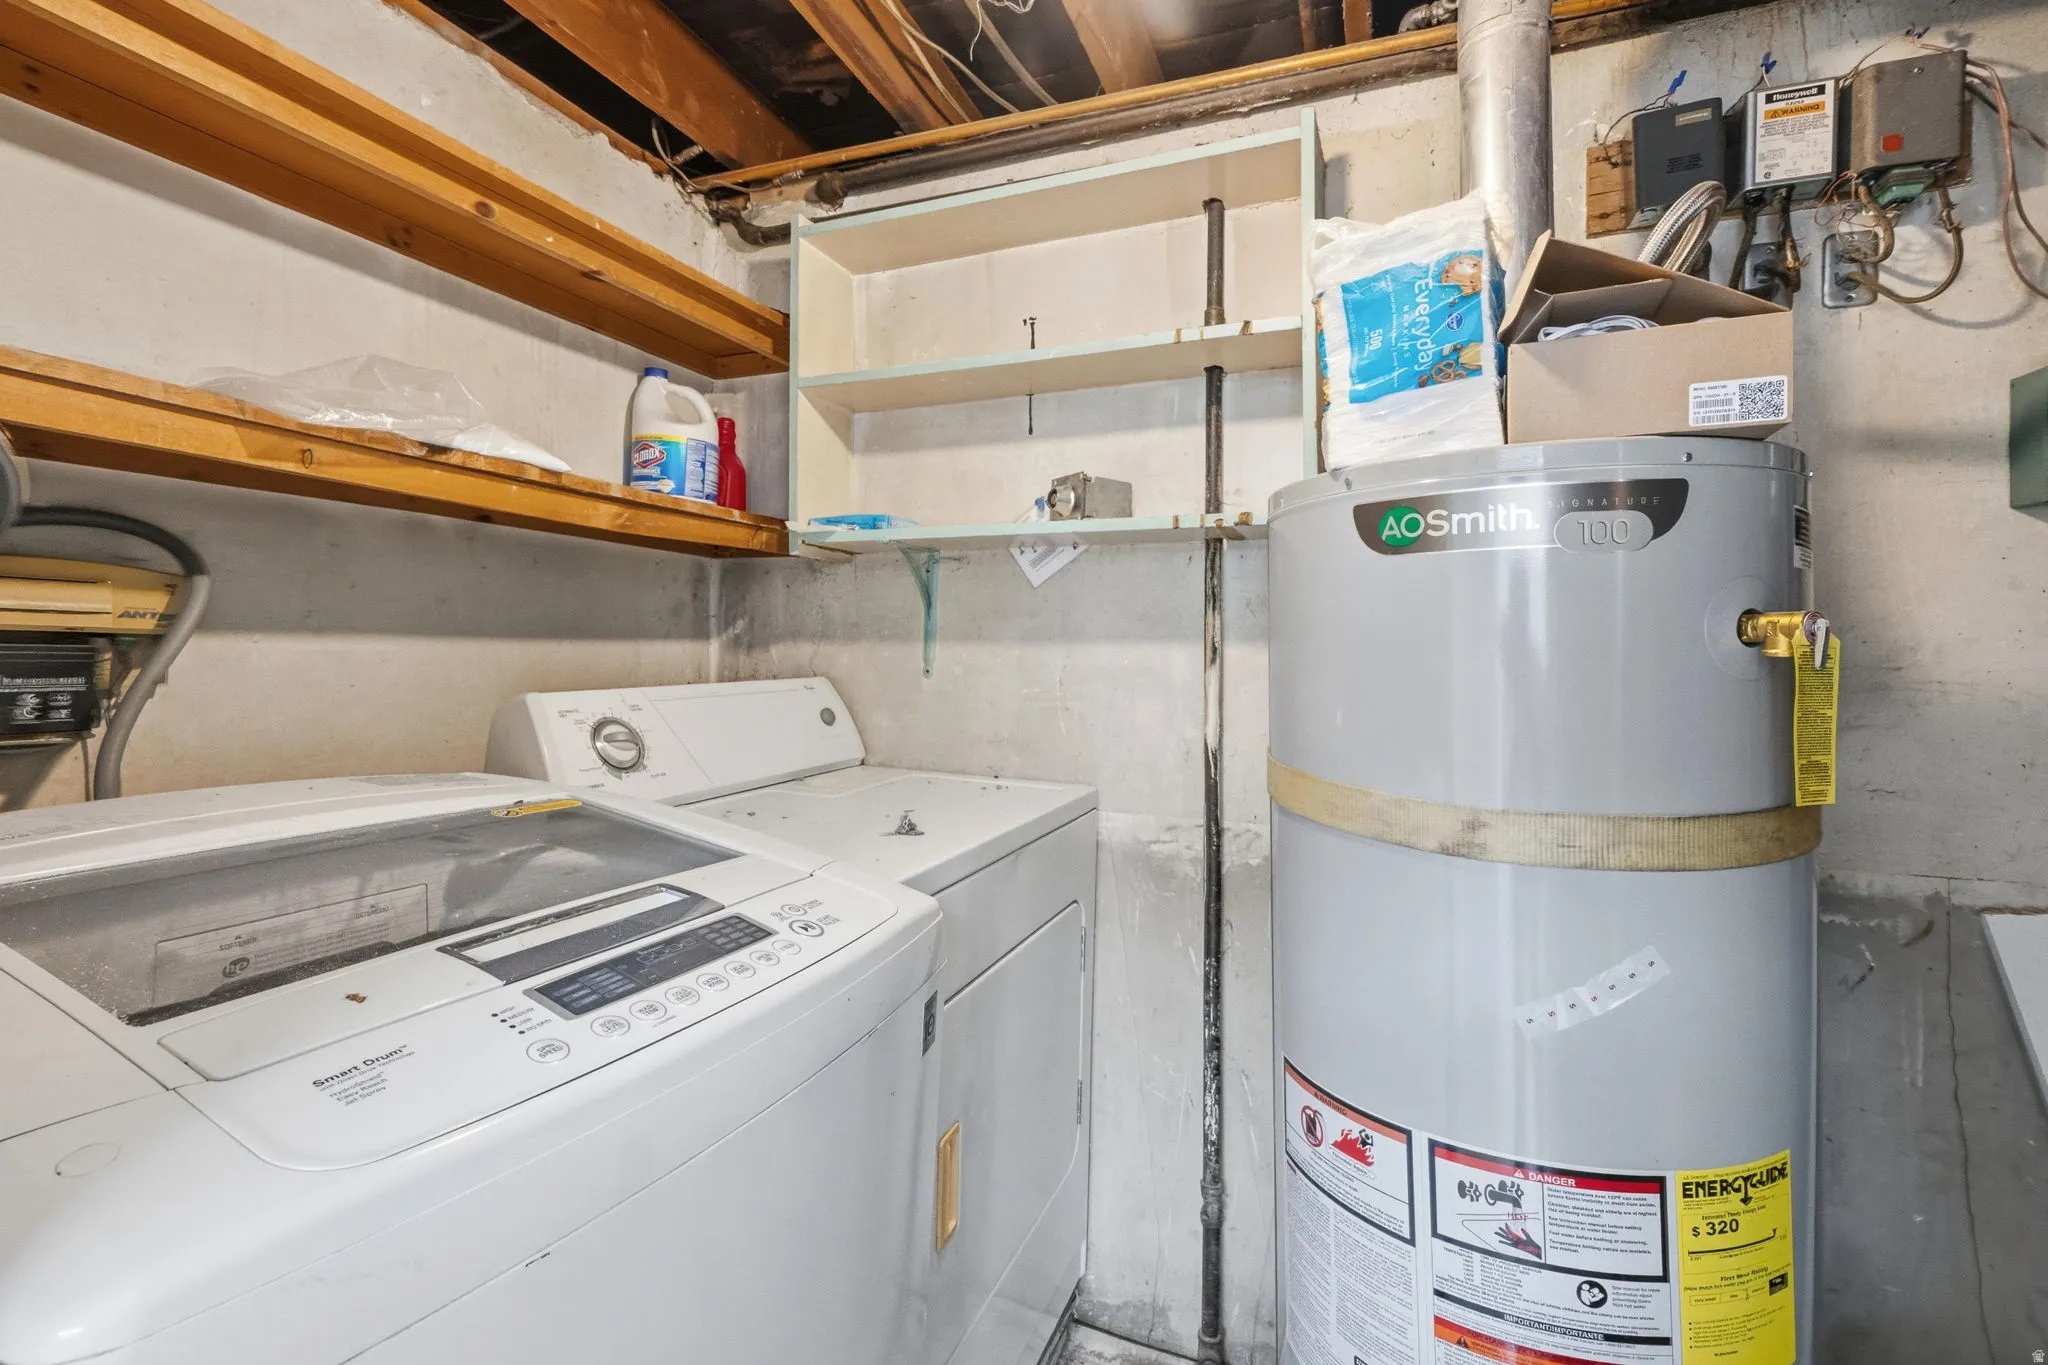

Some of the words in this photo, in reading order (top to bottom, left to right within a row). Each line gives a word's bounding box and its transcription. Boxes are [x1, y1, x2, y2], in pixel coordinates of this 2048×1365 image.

[1773, 87, 1818, 101] Honeywell
[1781, 103, 1819, 116] WARNING
[1401, 305, 1411, 358] NAPKINS
[1414, 278, 1436, 371] Everyday
[1369, 329, 1383, 351] 500
[1548, 496, 1660, 509] SIGNATURE
[1577, 518, 1630, 545] 100
[508, 1007, 534, 1020] MEDIUM
[518, 1017, 533, 1026] LOW
[539, 1045, 564, 1059] SPEED
[312, 1065, 361, 1088] Smart
[336, 1090, 360, 1102] Easy
[359, 1086, 387, 1099] Spray
[1528, 1172, 1576, 1188] DANGER
[1692, 1226, 1701, 1238] $
[1705, 1218, 1740, 1236] 320
